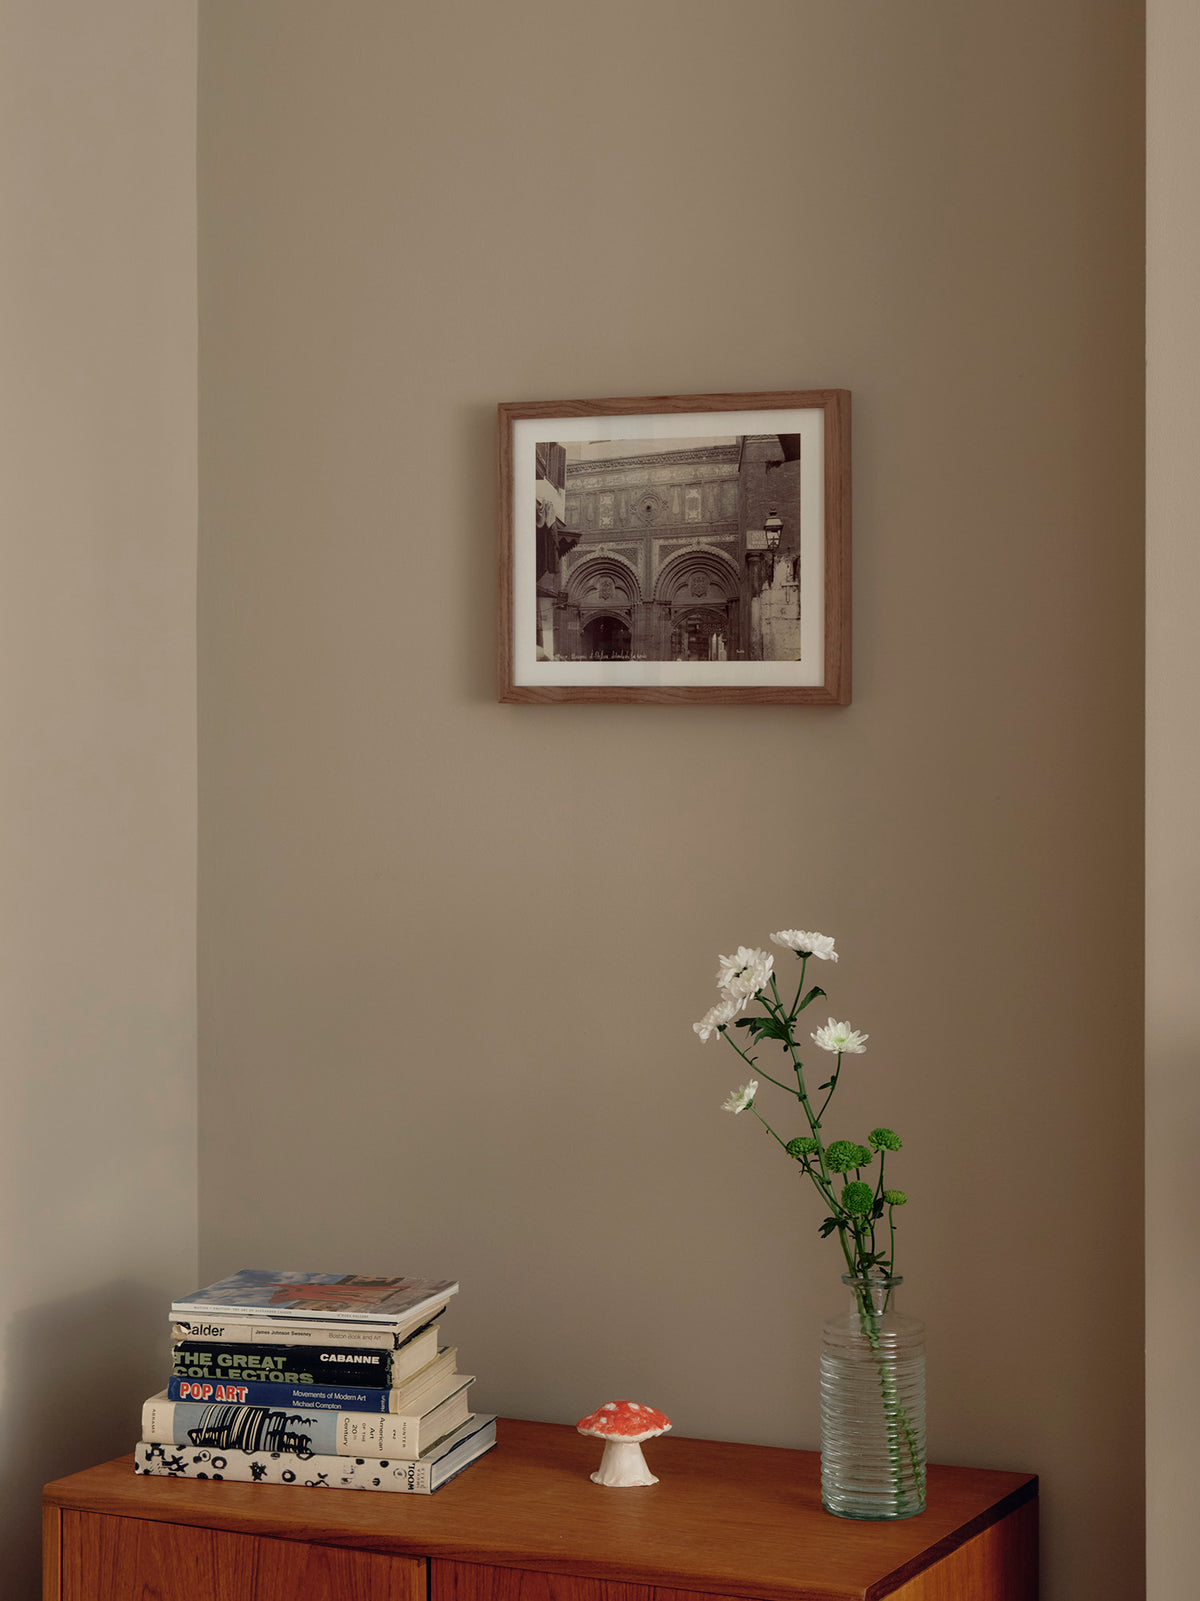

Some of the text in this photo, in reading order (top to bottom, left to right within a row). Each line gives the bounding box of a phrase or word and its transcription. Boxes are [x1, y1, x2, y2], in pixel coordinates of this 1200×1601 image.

[174, 1351, 287, 1369] THE GREAT
[320, 1353, 380, 1365] CABANNE
[173, 1366, 314, 1384] COLLECTORS
[180, 1382, 249, 1403] POP ART
[293, 1390, 326, 1399] Movements
[334, 1393, 357, 1401] Modern
[292, 1400, 342, 1410] Michael Compton
[408, 1462, 416, 1490] WOOL
